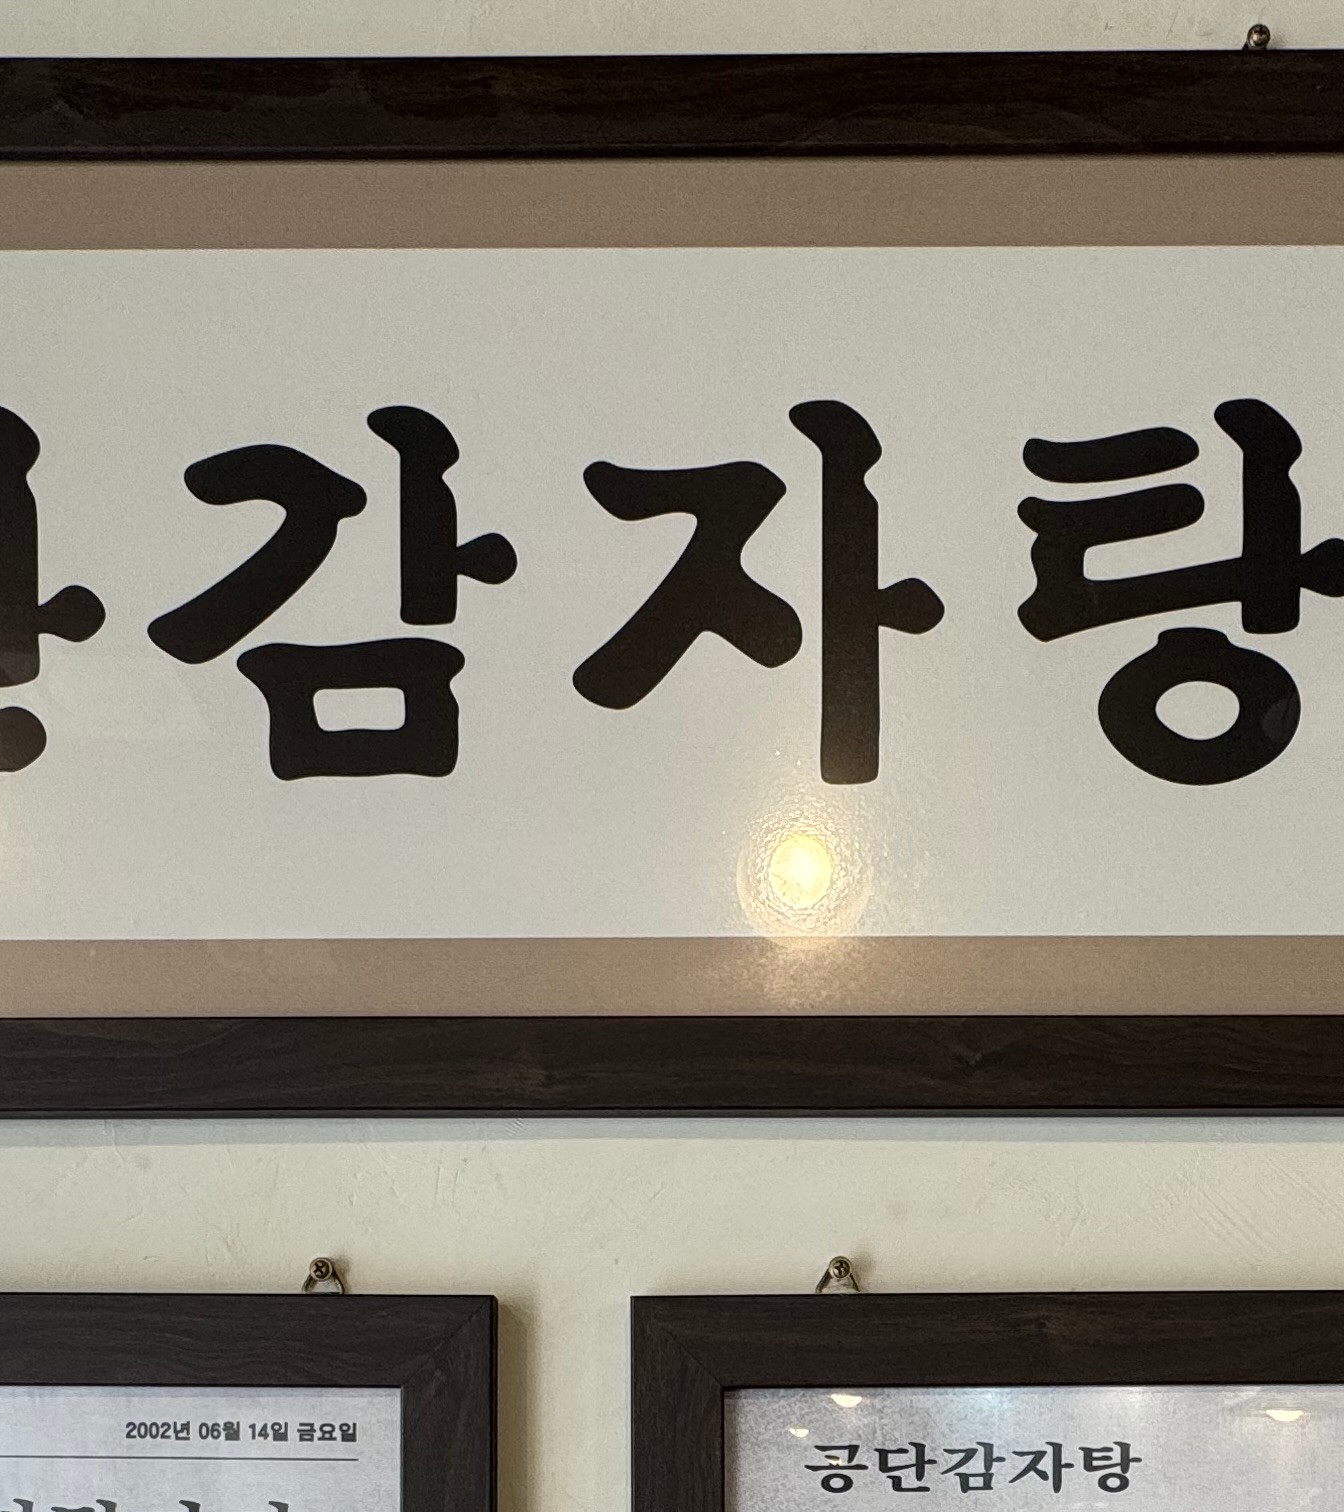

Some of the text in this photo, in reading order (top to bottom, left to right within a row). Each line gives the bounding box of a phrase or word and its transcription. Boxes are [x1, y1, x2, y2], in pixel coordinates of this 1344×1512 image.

[125, 1419, 358, 1443] 2002년 06월 14일 금요일
[804, 1440, 1143, 1495] 공단감자탕
